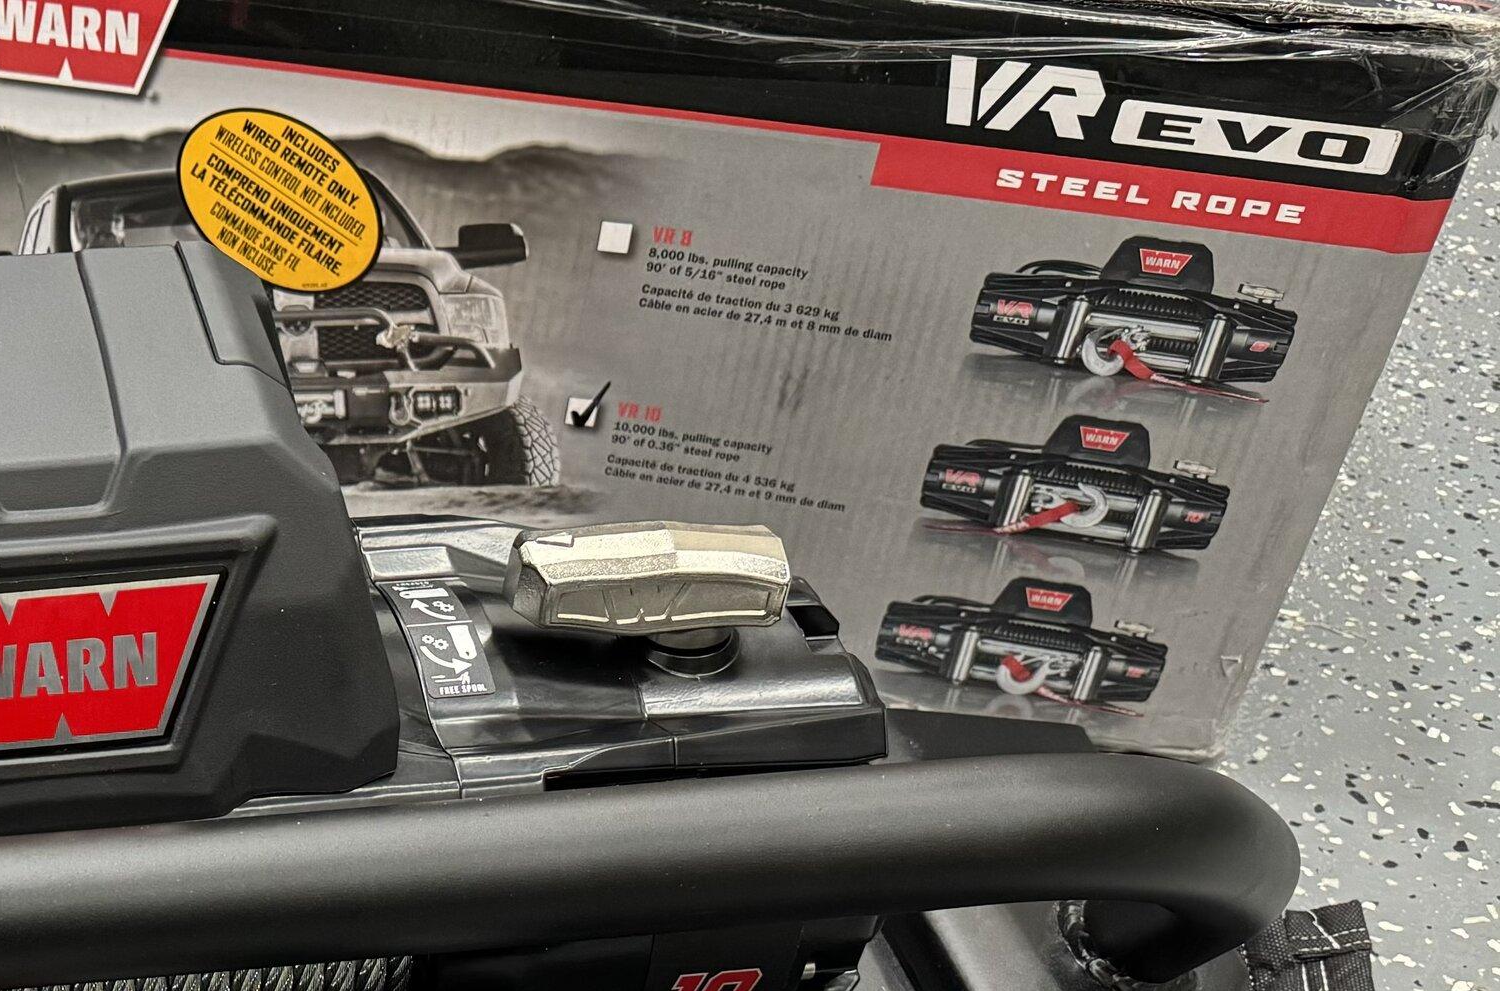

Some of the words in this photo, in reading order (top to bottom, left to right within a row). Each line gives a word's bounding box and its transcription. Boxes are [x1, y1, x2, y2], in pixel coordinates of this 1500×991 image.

[946, 54, 1106, 140] VR
[1137, 110, 1371, 166] EVO
[243, 119, 281, 153] WIRED
[280, 147, 328, 186] REMOTE
[328, 182, 360, 209] ONLY.
[281, 125, 340, 173] INCLUDES
[215, 125, 261, 164] WIRELESS
[259, 157, 301, 194] CONTROL
[300, 185, 321, 207] NOT
[319, 196, 366, 240] INCLUDED.
[996, 169, 1150, 205] STEEL
[1171, 190, 1306, 225] ROPE
[191, 163, 206, 183] LA
[208, 175, 299, 244] TÉLÉCOMMANDE
[298, 238, 342, 277] FILAIRE.
[207, 153, 270, 203] COMPREND
[271, 197, 344, 254] UNIQUEMENT
[210, 201, 262, 244] COMMANDE
[260, 234, 287, 265] SANS
[286, 252, 301, 272] FIL
[217, 228, 236, 249] NON
[649, 248, 684, 260] 8,000
[688, 253, 708, 265] lbs.
[713, 258, 754, 272] pulling
[756, 263, 808, 280] capacity
[669, 265, 682, 275] of
[726, 274, 756, 286] steel
[759, 280, 785, 290] rope
[1145, 256, 1183, 269] WARN
[639, 298, 671, 310] Câble
[675, 305, 689, 313] en
[693, 307, 723, 318] acier
[726, 311, 741, 320] de
[776, 318, 786, 327] m
[791, 320, 803, 330] et
[807, 321, 815, 331] 8
[819, 324, 841, 334] mm
[844, 326, 859, 337] de
[863, 328, 892, 341] diam
[641, 284, 693, 300] Capacité
[697, 292, 711, 302] de
[716, 295, 762, 309] traction
[766, 301, 780, 311] du
[784, 304, 792, 313] 3
[796, 305, 820, 317] 629
[824, 309, 840, 321] kg
[614, 421, 655, 436] 10,000
[659, 428, 678, 439] lbs.
[682, 433, 721, 447] pulling
[723, 439, 772, 455] capacity
[633, 437, 645, 446] of
[683, 446, 712, 458] steel
[715, 452, 740, 462] rope
[1085, 433, 1119, 445] WARN
[605, 466, 636, 479] Câble
[639, 473, 653, 482] en
[656, 475, 685, 486] acier
[687, 479, 701, 489] de
[734, 488, 745, 496] m
[749, 490, 760, 499] et
[764, 491, 772, 501] 9
[775, 494, 797, 504] mm
[800, 497, 813, 507] de
[607, 454, 656, 469] Capacité
[660, 462, 674, 472] de
[678, 465, 722, 479] traction
[725, 472, 738, 482] du
[742, 475, 750, 484] 4
[754, 476, 776, 488] 536
[780, 480, 795, 492] kg
[439, 686, 460, 695] FREE
[461, 684, 487, 693] SPOOL
